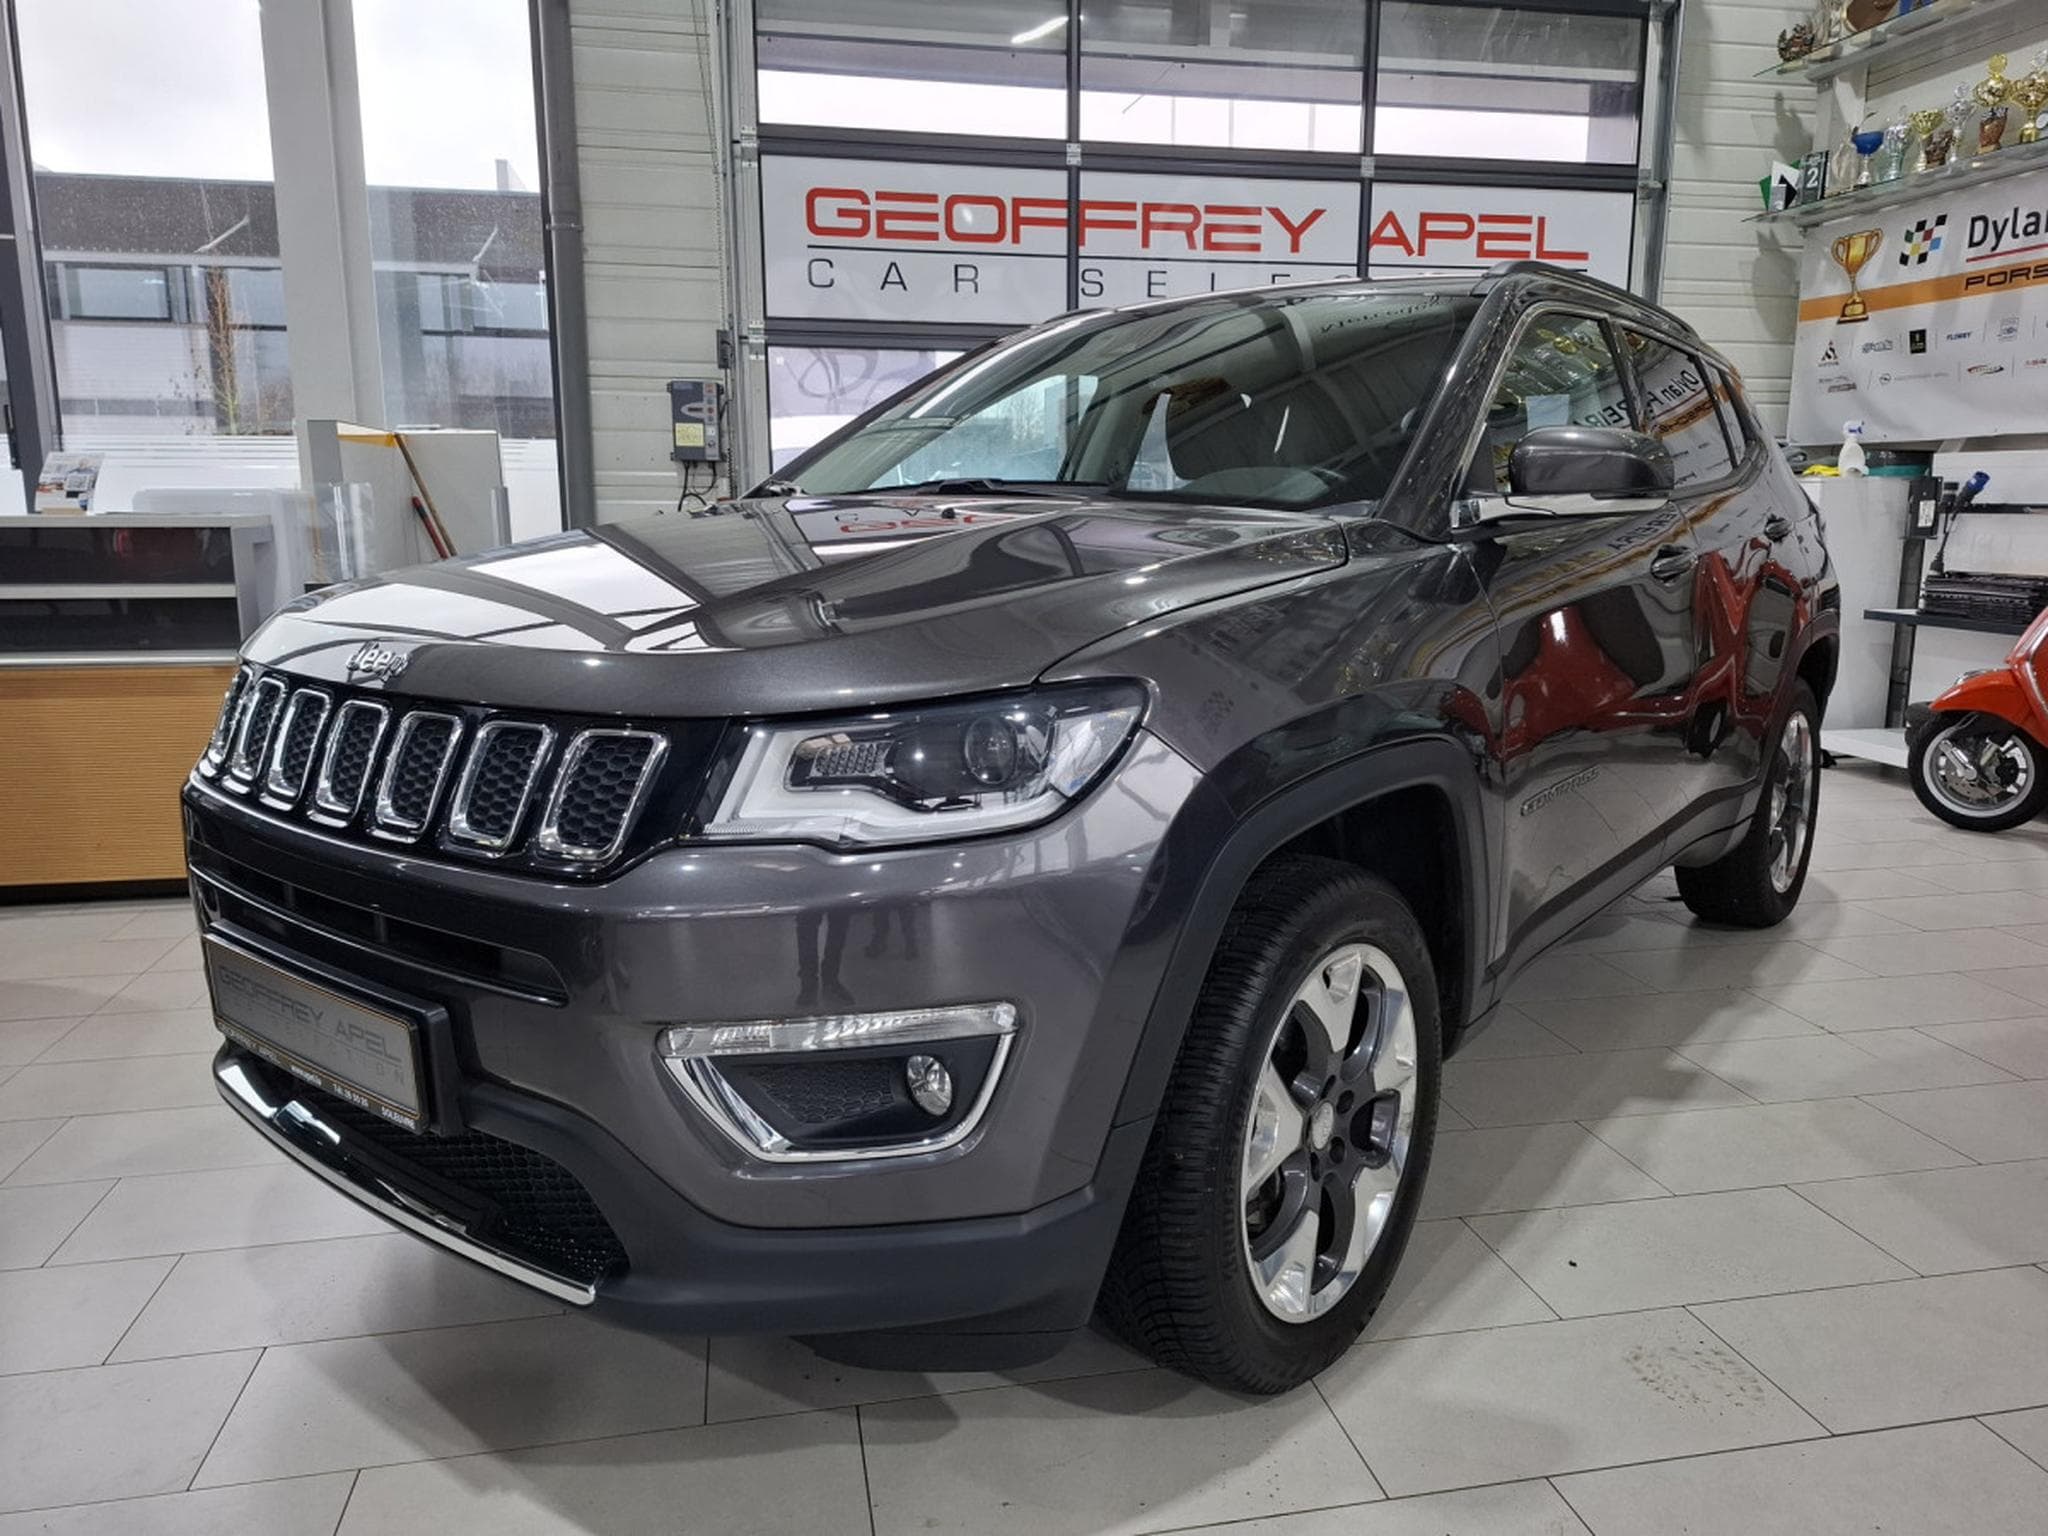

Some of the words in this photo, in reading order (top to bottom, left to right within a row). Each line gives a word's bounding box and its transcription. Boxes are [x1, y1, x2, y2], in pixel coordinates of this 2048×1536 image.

[1806, 167, 1818, 188] 2
[805, 187, 1327, 254] GEOFFREY
[1368, 210, 1590, 261] APEL
[1967, 206, 2048, 253] Dyla
[807, 258, 979, 294] CAR
[345, 640, 409, 683] Jeep
[335, 1020, 403, 1063] APEL
